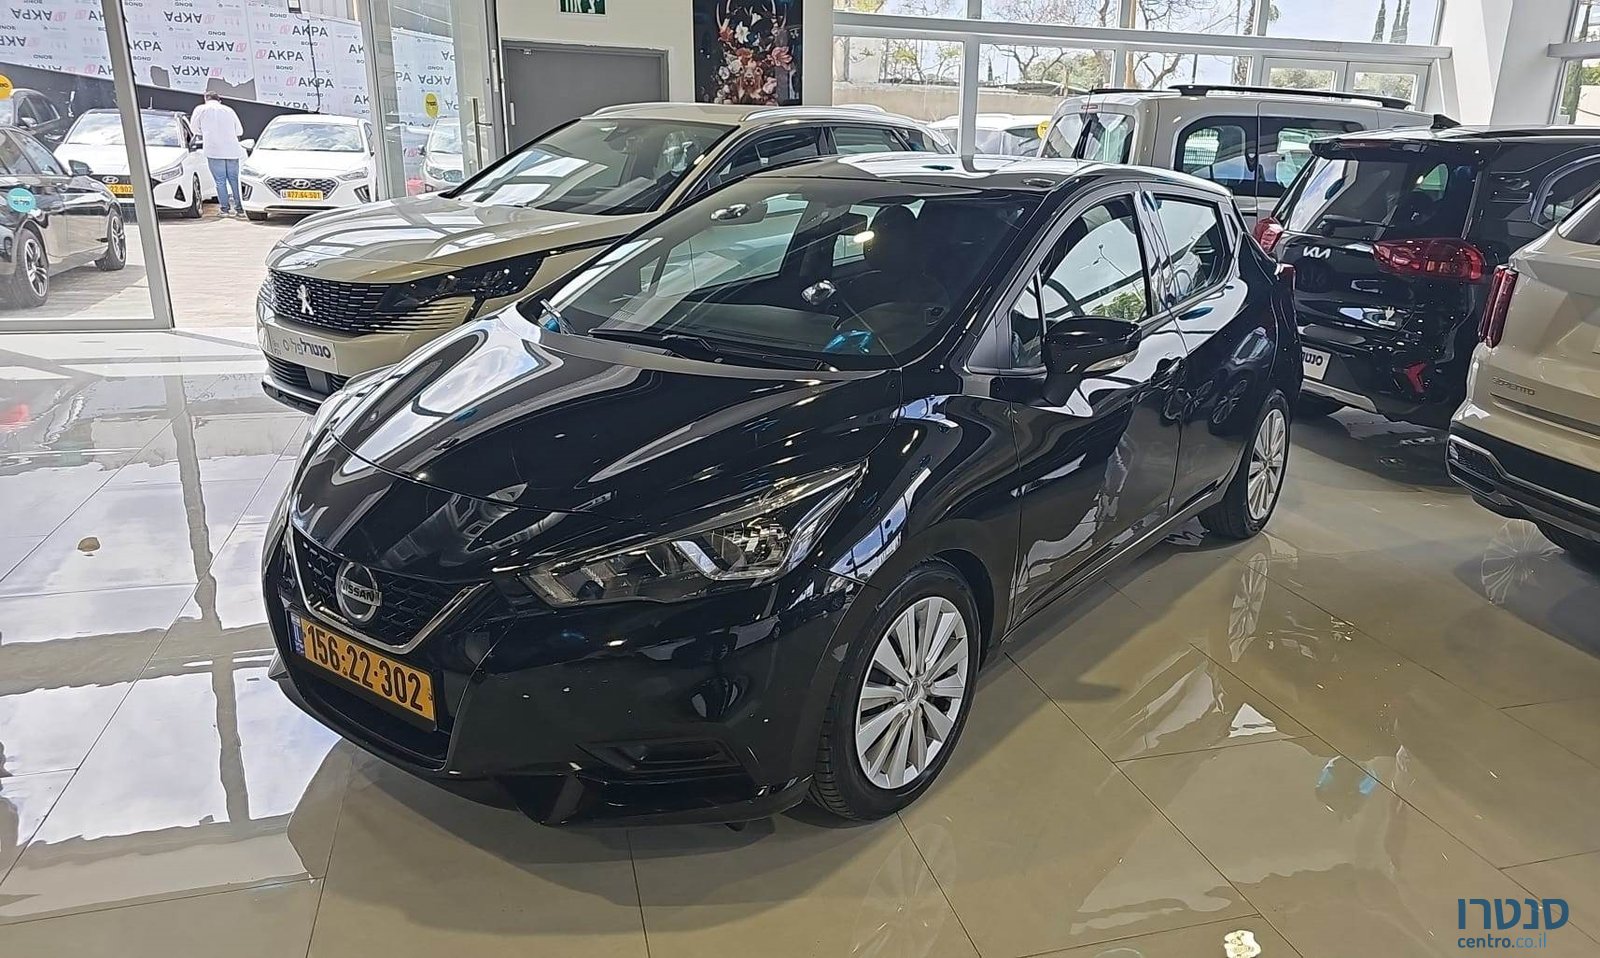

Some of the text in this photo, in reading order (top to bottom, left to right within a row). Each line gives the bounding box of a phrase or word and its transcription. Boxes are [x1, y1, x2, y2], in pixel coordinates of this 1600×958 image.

[10, 8, 52, 20] AKPA
[164, 11, 202, 23] AKPA
[292, 25, 328, 37] AKPA
[196, 39, 235, 52] AKPA
[267, 50, 304, 61] AKPA
[172, 64, 210, 76] AKPA
[298, 77, 334, 88] AKPA
[418, 75, 451, 85] AKPA
[1303, 246, 1331, 259] KIA
[341, 579, 376, 602] NISSAN
